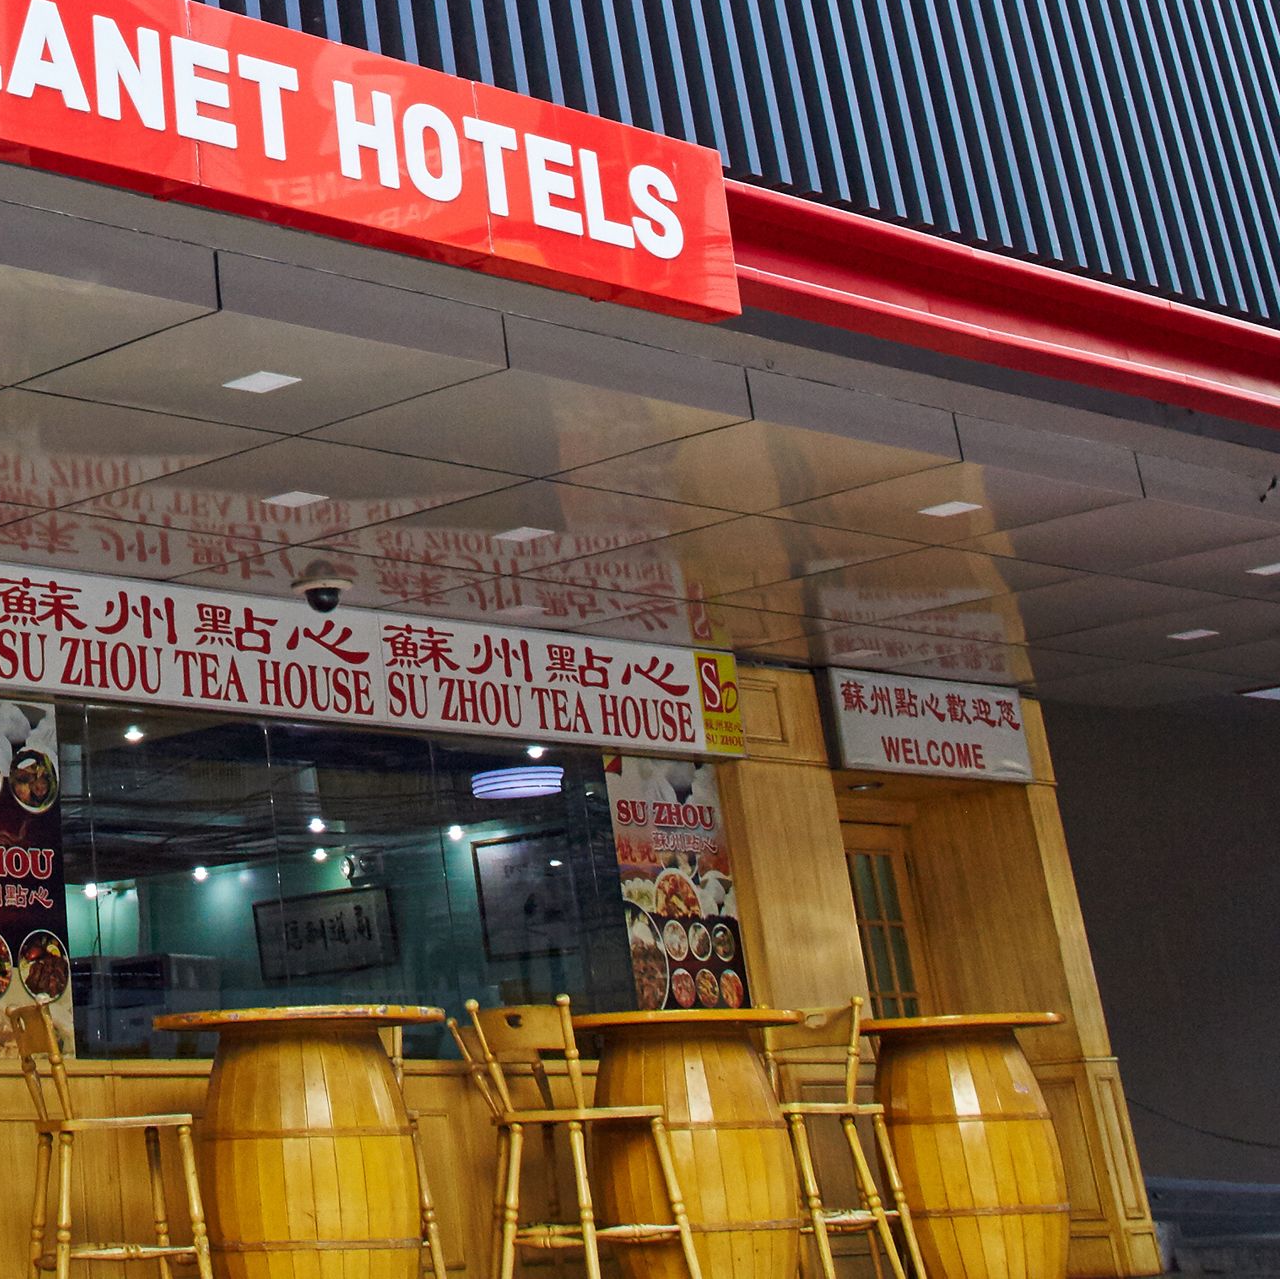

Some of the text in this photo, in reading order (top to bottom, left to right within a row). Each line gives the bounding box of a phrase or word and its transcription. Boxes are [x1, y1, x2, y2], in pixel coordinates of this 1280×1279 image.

[331, 79, 686, 261] HOTELS
[59, 636, 163, 694] ZHOU
[174, 649, 248, 703] TEA
[257, 659, 375, 716] HOUSE
[389, 671, 428, 719] SU
[438, 676, 522, 729] ZHOU
[531, 686, 592, 734] TEA
[598, 693, 696, 743] HOUSE
[382, 623, 690, 697] 蘇州點心
[881, 735, 986, 769] WELCOME
[616, 799, 715, 830] SU ZHOU
